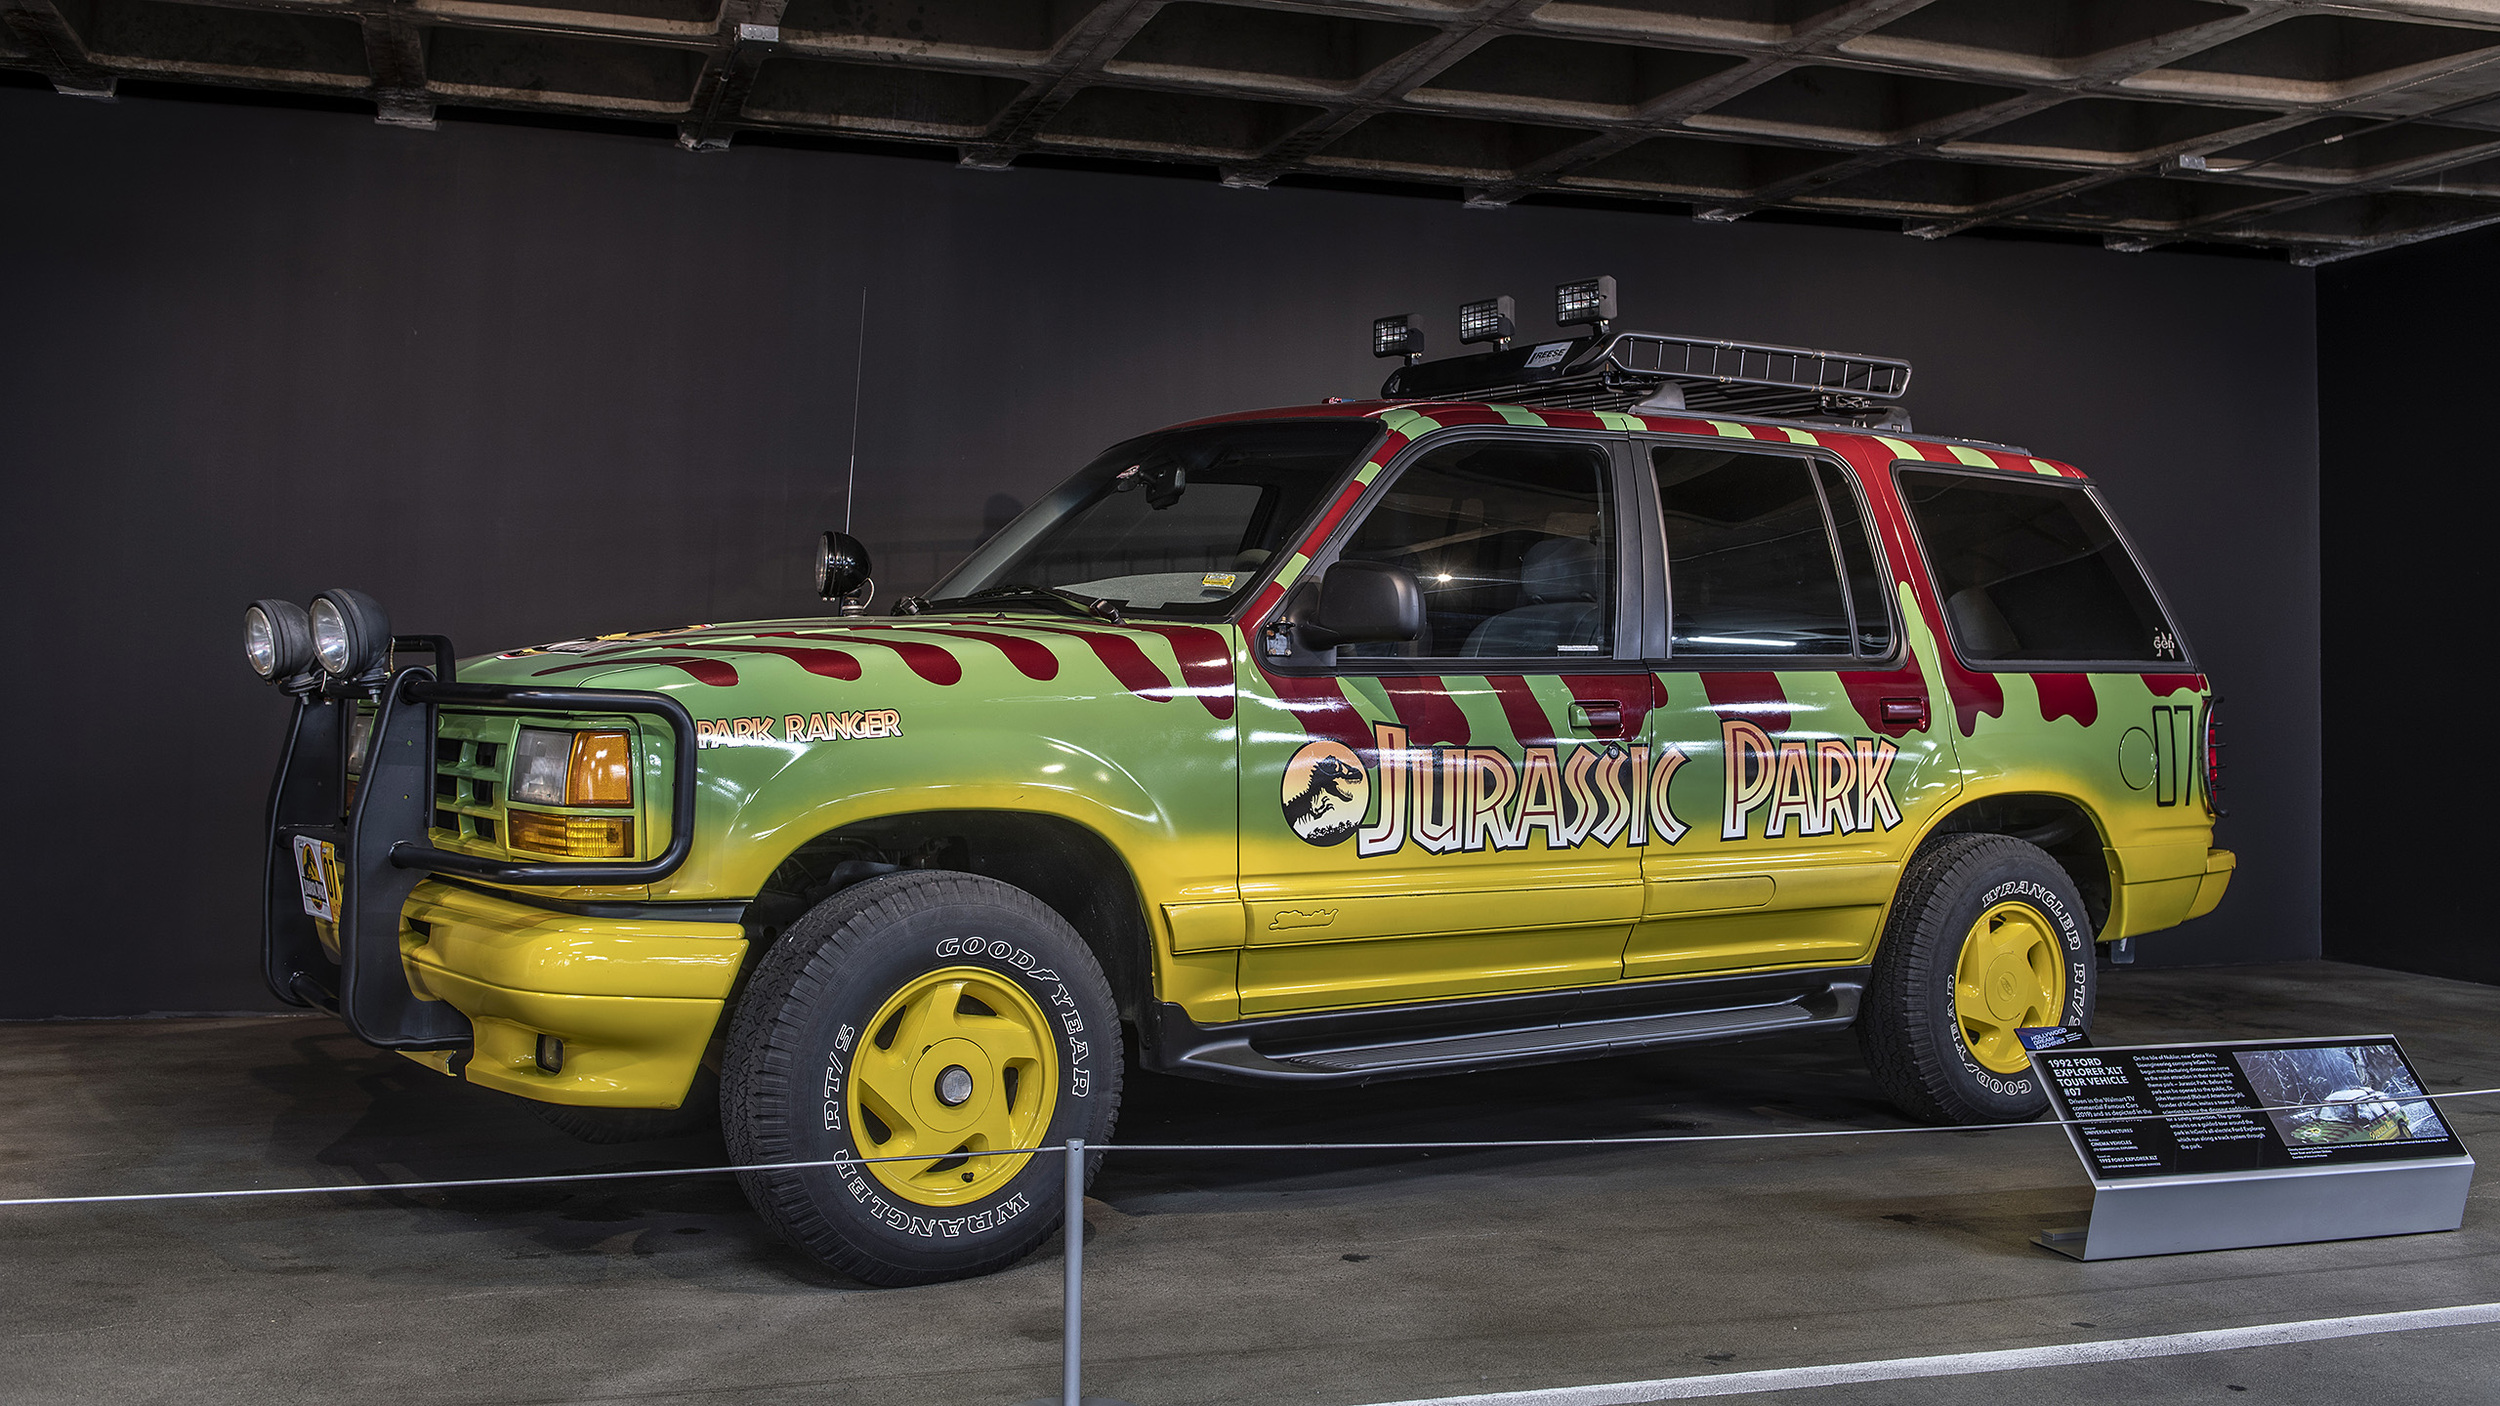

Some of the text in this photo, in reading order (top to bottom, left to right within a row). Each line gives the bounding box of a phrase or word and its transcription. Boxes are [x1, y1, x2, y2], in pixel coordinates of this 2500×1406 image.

[1535, 348, 1566, 359] REESE
[696, 708, 904, 750] PARK RANGER
[2152, 705, 2194, 808] 07
[1357, 718, 1903, 858] JURASSIC PARK
[1981, 880, 2082, 951] WRANGLER
[935, 935, 1091, 1098] GOODYEAR
[1945, 973, 2032, 1096] GOODYEAR
[2030, 1027, 2067, 1041] HOLLYWOOD
[2033, 1036, 2055, 1046] DREAM
[2036, 1038, 2067, 1050] MACHINES
[2048, 1057, 2102, 1068] 1992 FORD
[2053, 1066, 2124, 1077] EXPLORER XLT
[2056, 1075, 2130, 1087] TOUR VEHICLE
[2063, 1087, 2081, 1097] #07
[822, 1022, 1031, 1239] WRANGLER RT/S
